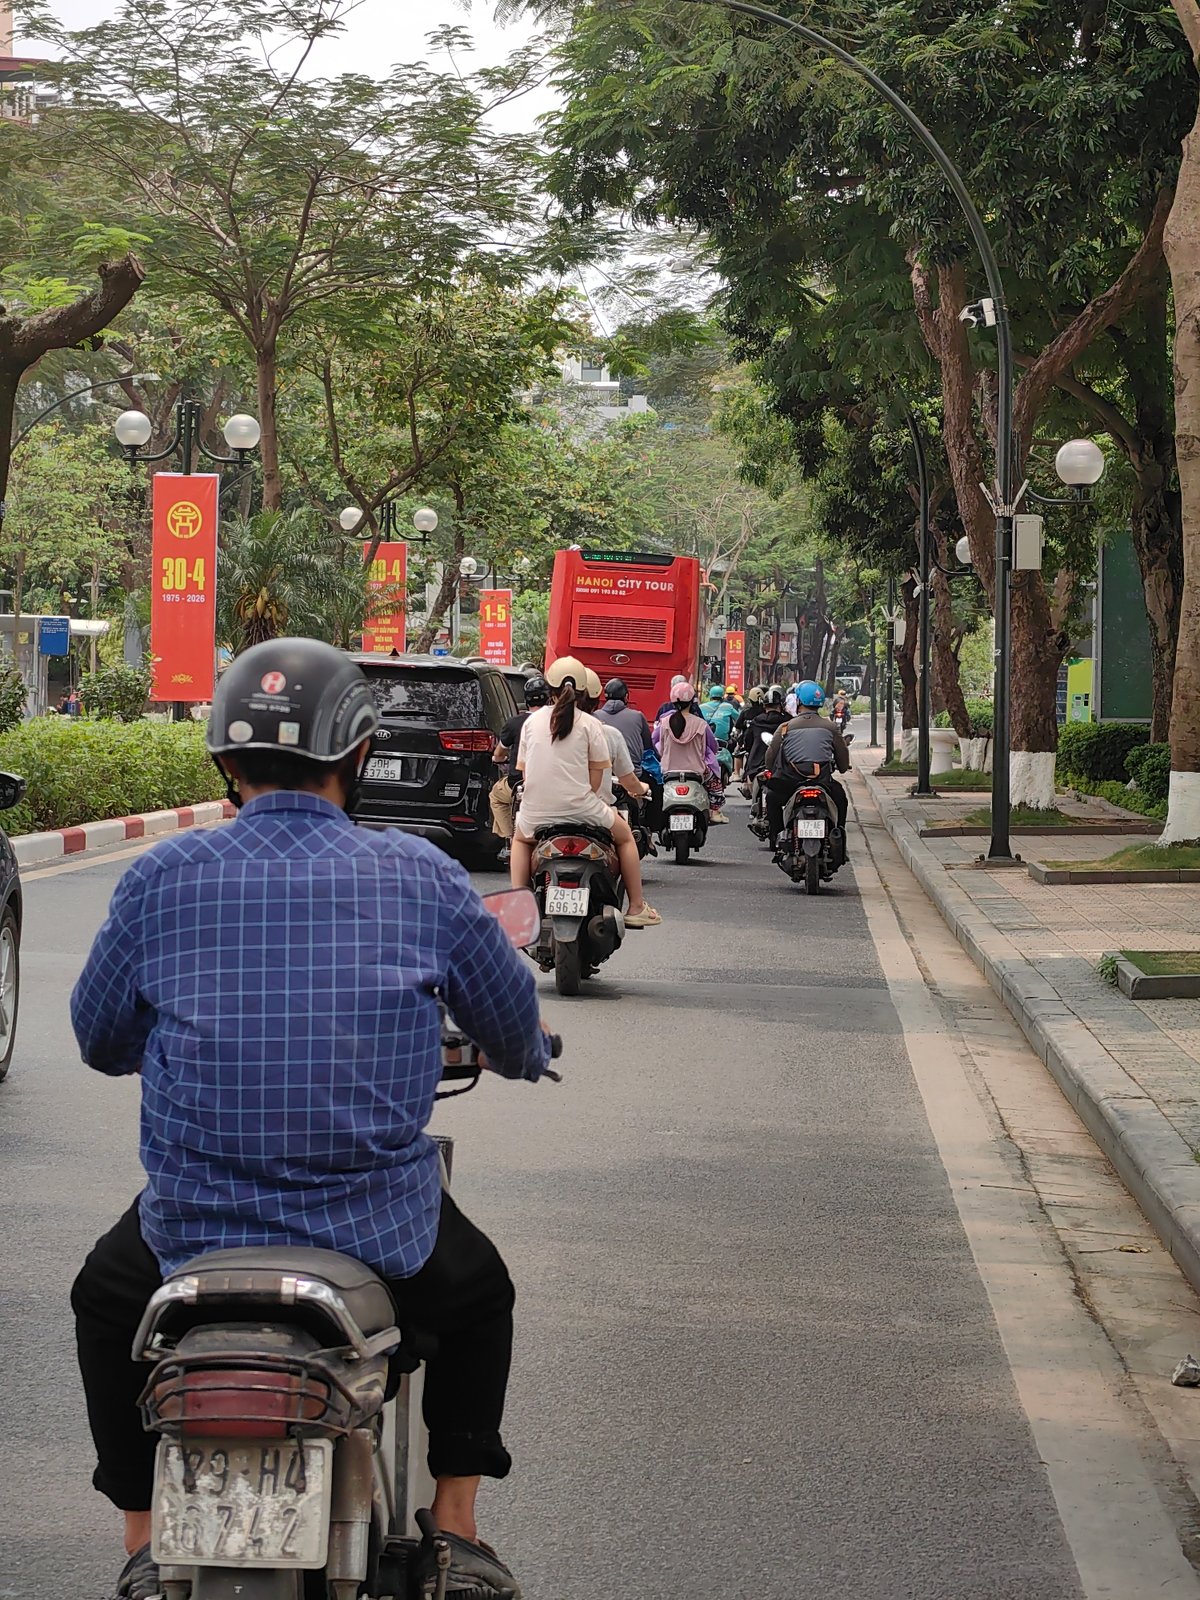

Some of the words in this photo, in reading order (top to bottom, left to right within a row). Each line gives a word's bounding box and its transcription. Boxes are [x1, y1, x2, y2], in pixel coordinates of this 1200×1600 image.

[576, 576, 614, 588] HANOI
[617, 577, 642, 589] CITY
[645, 581, 675, 592] TOUR
[162, 594, 180, 602] 1975
[186, 594, 206, 603] 2026
[484, 604, 506, 622] 1-5
[729, 639, 742, 650] 1-5
[371, 759, 390, 768] 30H
[553, 889, 582, 901] 29-C1
[548, 901, 585, 914] 696.34
